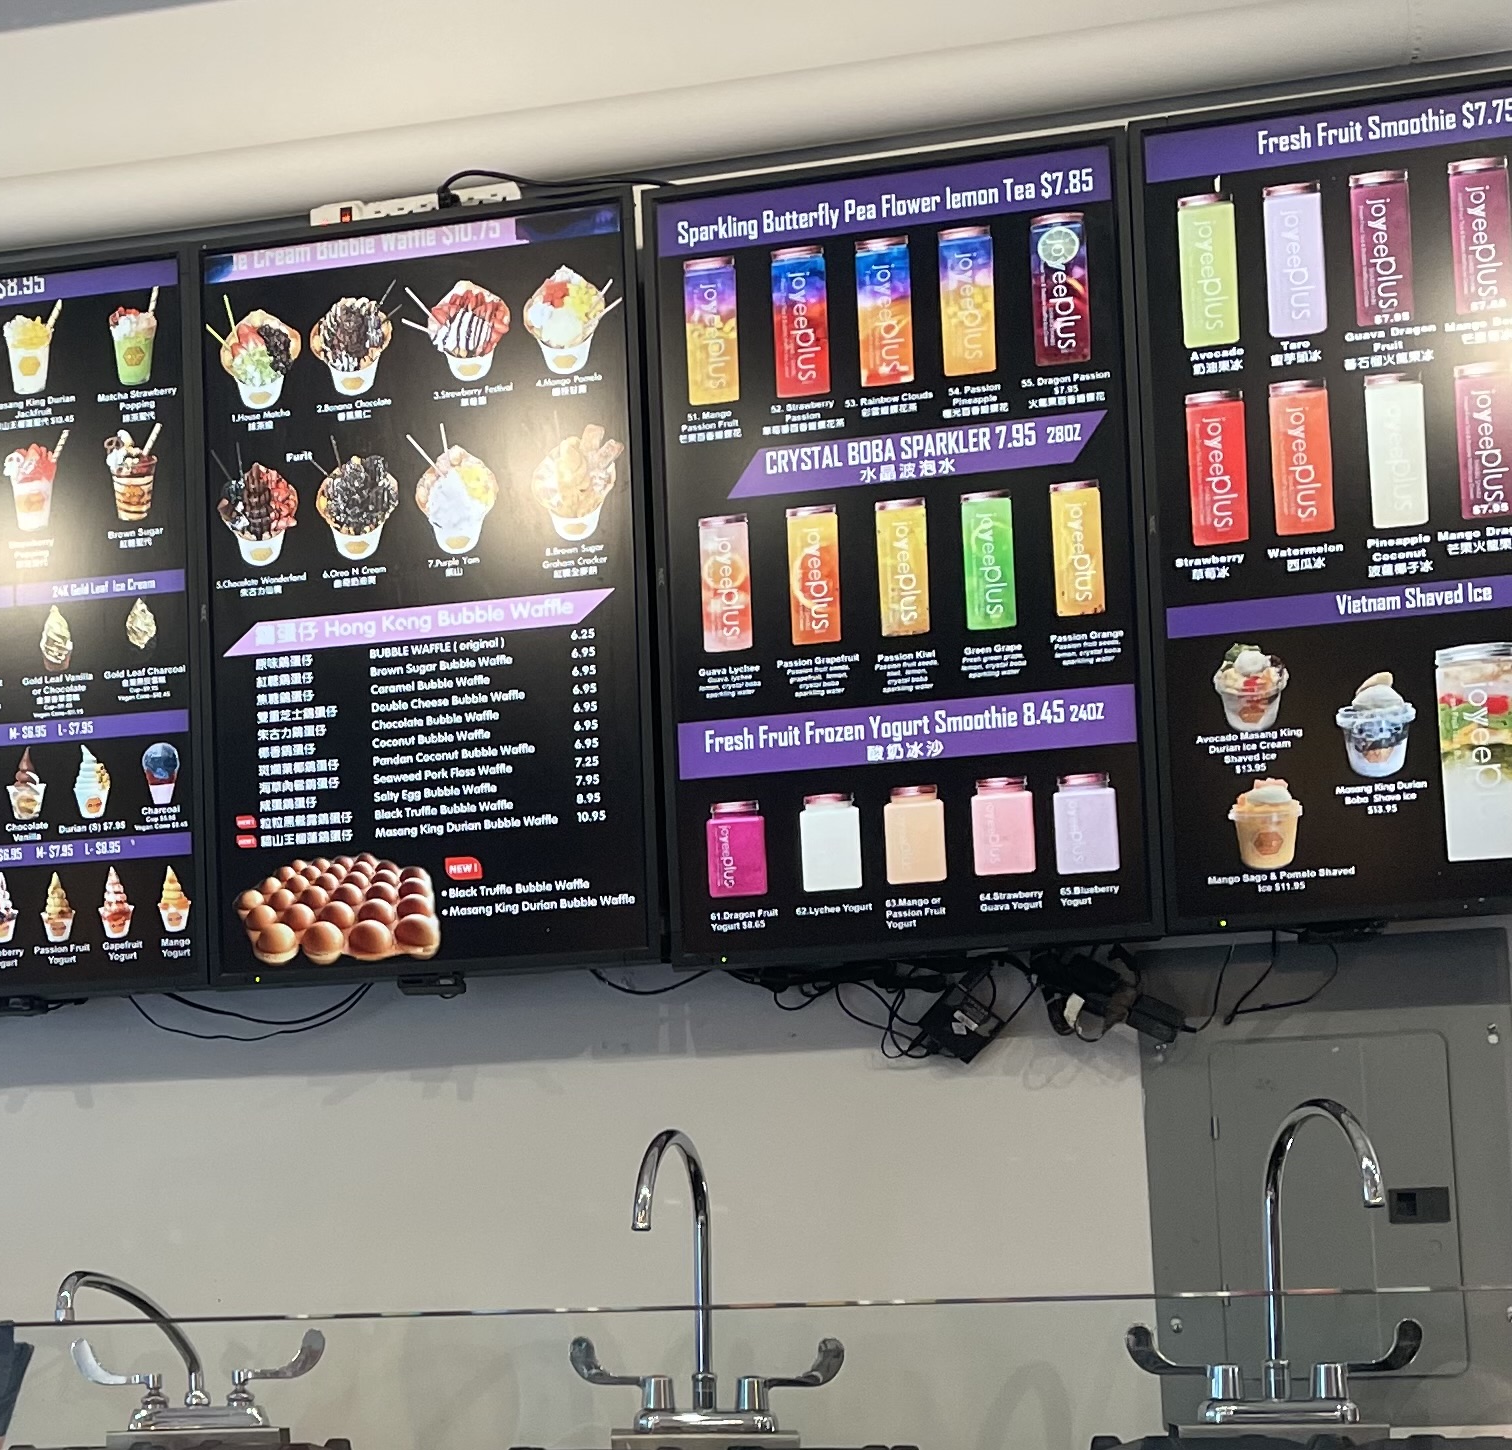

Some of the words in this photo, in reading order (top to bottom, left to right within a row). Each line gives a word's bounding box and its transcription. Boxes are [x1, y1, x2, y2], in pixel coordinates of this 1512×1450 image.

[1258, 127, 1311, 155] Fresh
[1317, 121, 1363, 146] Fruit
[1368, 109, 1456, 141] Smoothie
[1461, 99, 1512, 129] $7.75
[677, 215, 758, 247] Sparkling
[763, 202, 840, 234] Butterfly
[844, 199, 877, 224] Pea
[881, 188, 940, 218] Flower
[946, 185, 999, 209] lemon
[1003, 179, 1035, 203] Tea
[1040, 168, 1094, 199] $7.85
[1365, 198, 1402, 313] joyeeplus
[1040, 236, 1081, 353] joyeeplus
[1345, 329, 1385, 342] Guava
[1390, 323, 1437, 337] Dragon
[1190, 347, 1244, 361] Avocado
[1280, 340, 1310, 350] Taro
[1373, 341, 1403, 352] Fruit
[766, 443, 843, 476] CRYSTAL
[847, 435, 897, 466] BOBA
[900, 426, 990, 461] SPARKLER
[996, 423, 1036, 450] 7.95
[1046, 424, 1082, 444] 28OZ
[860, 458, 955, 483] 水晶波泡水
[1175, 552, 1244, 568] Strawberry
[1267, 543, 1344, 559] Watermelon
[1336, 594, 1401, 615] Vietnam
[1405, 588, 1463, 609] Shaved
[1468, 583, 1493, 603] Ice
[324, 620, 376, 638] Hong
[382, 615, 432, 635] Kong
[437, 606, 505, 627] Bubble
[509, 599, 574, 619] Waffle
[571, 628, 595, 640] 6.25
[369, 645, 409, 659] BUBBLE
[411, 642, 451, 655] WAFFLE
[571, 646, 596, 659] 6.95
[370, 664, 404, 678] Brown
[405, 662, 437, 675] Sugar
[440, 659, 475, 671] Bubble
[477, 655, 513, 667] Waffle
[69, 722, 94, 735] $7.95
[705, 728, 754, 753] Fresh
[759, 722, 801, 747] Fruit
[805, 715, 865, 743] Frozen
[869, 709, 930, 741] Yogurt
[935, 704, 1018, 734] Smoothie
[1022, 700, 1065, 724] 8.45
[1069, 702, 1105, 721] 24OZ
[1196, 733, 1238, 746] Avocado
[1280, 727, 1303, 739] King
[575, 756, 599, 768] 7.25
[423, 769, 448, 781] Pork
[477, 763, 512, 775] Waffle
[375, 825, 418, 838] Masang
[420, 823, 444, 836] King
[446, 820, 482, 832] Durian
[484, 818, 520, 830] Bubble
[522, 814, 558, 826] Waffle
[576, 811, 606, 823] 10.95
[49, 845, 73, 857] $7.95
[449, 886, 477, 898] Black
[516, 881, 553, 894] Bubble
[555, 878, 590, 891] Waffle
[48, 955, 76, 965] Yogurt
